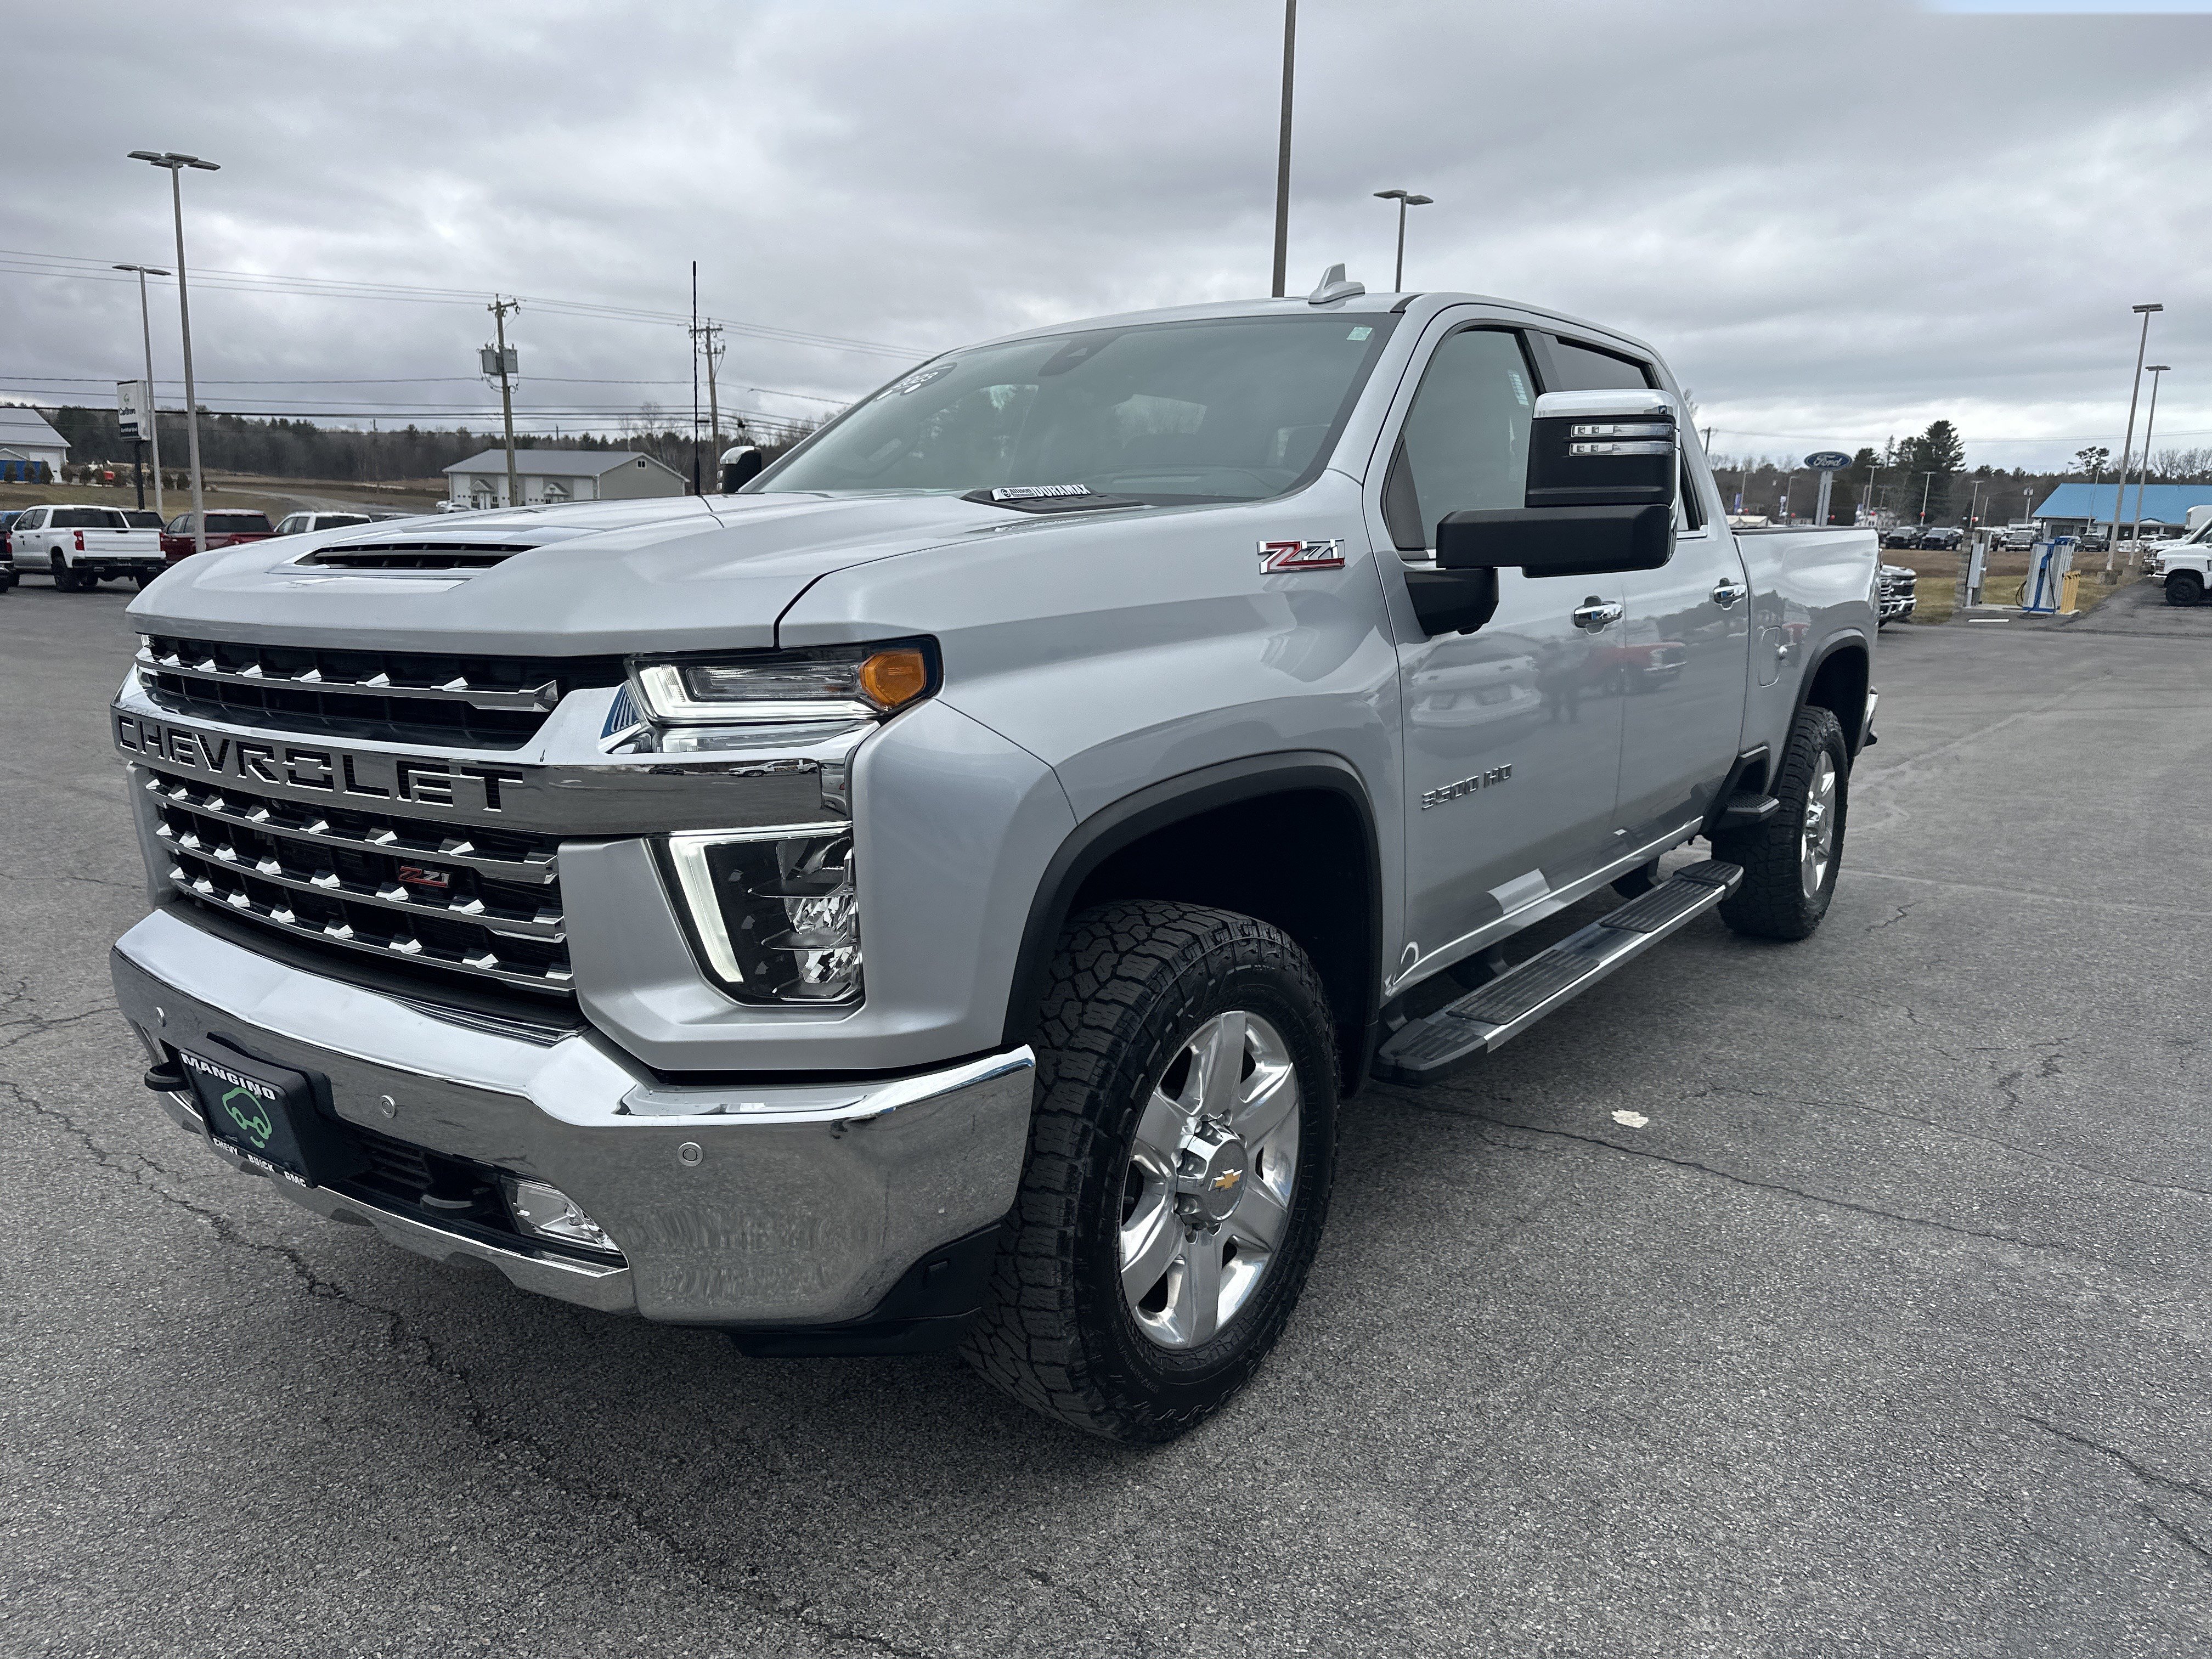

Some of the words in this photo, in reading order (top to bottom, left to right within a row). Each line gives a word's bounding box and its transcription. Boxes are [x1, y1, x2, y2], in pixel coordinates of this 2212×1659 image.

[1813, 455, 1843, 466] Ford
[1031, 484, 1091, 497] DURAMAX
[1256, 539, 1345, 574] Z71
[117, 714, 523, 812] CHEVROLET
[1421, 775, 1479, 810] 3500
[1483, 763, 1512, 788] HD
[398, 866, 450, 888] Z71
[180, 1053, 275, 1100] MANGINO
[213, 1137, 238, 1156] CHEVY
[247, 1154, 275, 1173] BUICK
[284, 1171, 306, 1187] GMC
